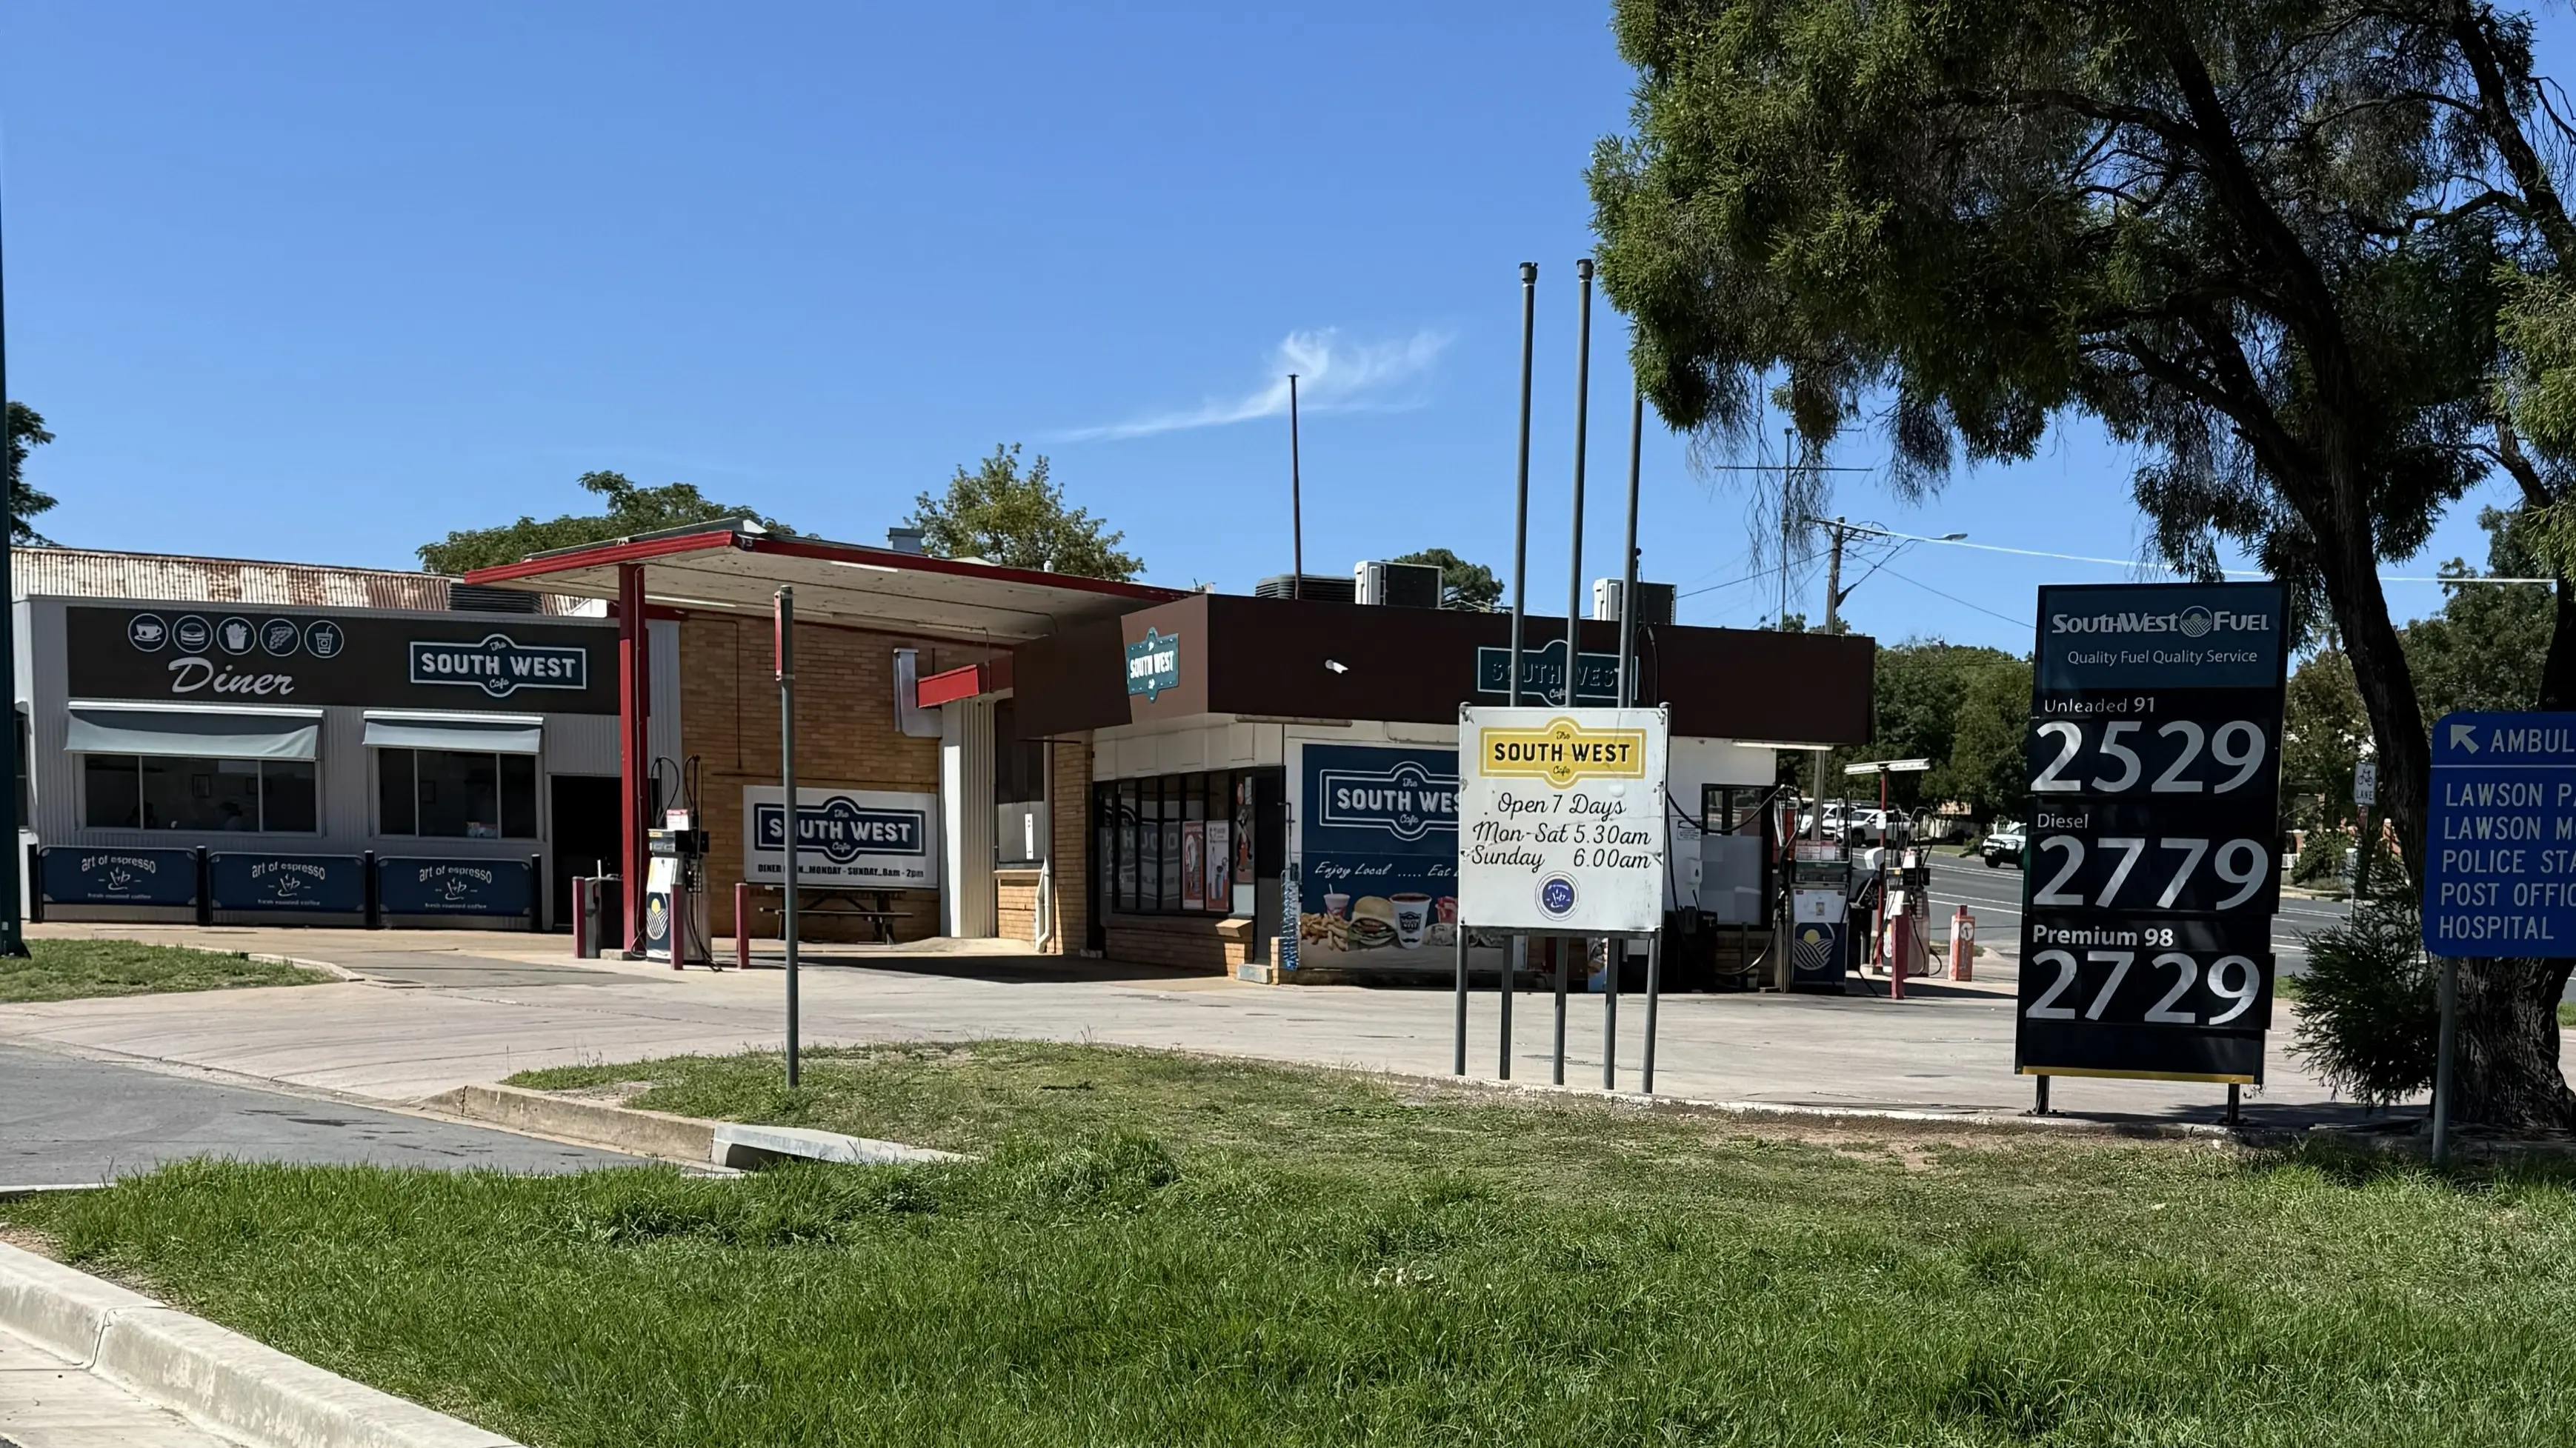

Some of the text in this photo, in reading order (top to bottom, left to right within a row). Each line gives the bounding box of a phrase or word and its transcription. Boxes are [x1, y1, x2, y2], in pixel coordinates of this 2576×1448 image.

[490, 641, 507, 651] The
[2067, 649, 2257, 667] Quality Fuel Quality Service
[168, 656, 294, 695] Diner
[421, 653, 576, 678] SOUTH WEST
[1130, 650, 1174, 678] SOUTH WEST
[2044, 696, 2154, 713] Unleaded 91
[1556, 730, 1571, 741] The
[2489, 729, 2575, 753] AMBUL
[1494, 742, 1631, 762] SOUTH WEST
[2031, 720, 2266, 794] 2529
[1402, 778, 1418, 787] The
[1337, 787, 1412, 812] SOUTH
[1498, 792, 1627, 822] Open 7 Days
[2357, 790, 2373, 801] LANE
[2445, 783, 2543, 807] LAWSON
[769, 818, 911, 842] SUTH WEST
[1473, 821, 1652, 845] Mon-Sat 5.30am
[2037, 813, 2089, 829] Diesel
[2444, 816, 2541, 840] LAWSON
[81, 855, 156, 874] art of espresso
[758, 864, 782, 873] DINER
[1314, 861, 1352, 879] Enjoy
[1354, 863, 1393, 875] Local
[1427, 864, 1452, 877] Eat
[1471, 844, 1651, 873] Sunday 6.00am
[2442, 850, 2526, 873] POLICE
[252, 861, 326, 881] art of espresso
[419, 865, 492, 884] art of espresso
[2033, 834, 2269, 911] 2779
[2440, 882, 2500, 907] POST
[2032, 924, 2174, 947] Premium 98
[2439, 915, 2555, 940] HOSPITAL
[2026, 949, 2260, 1026] 2729
